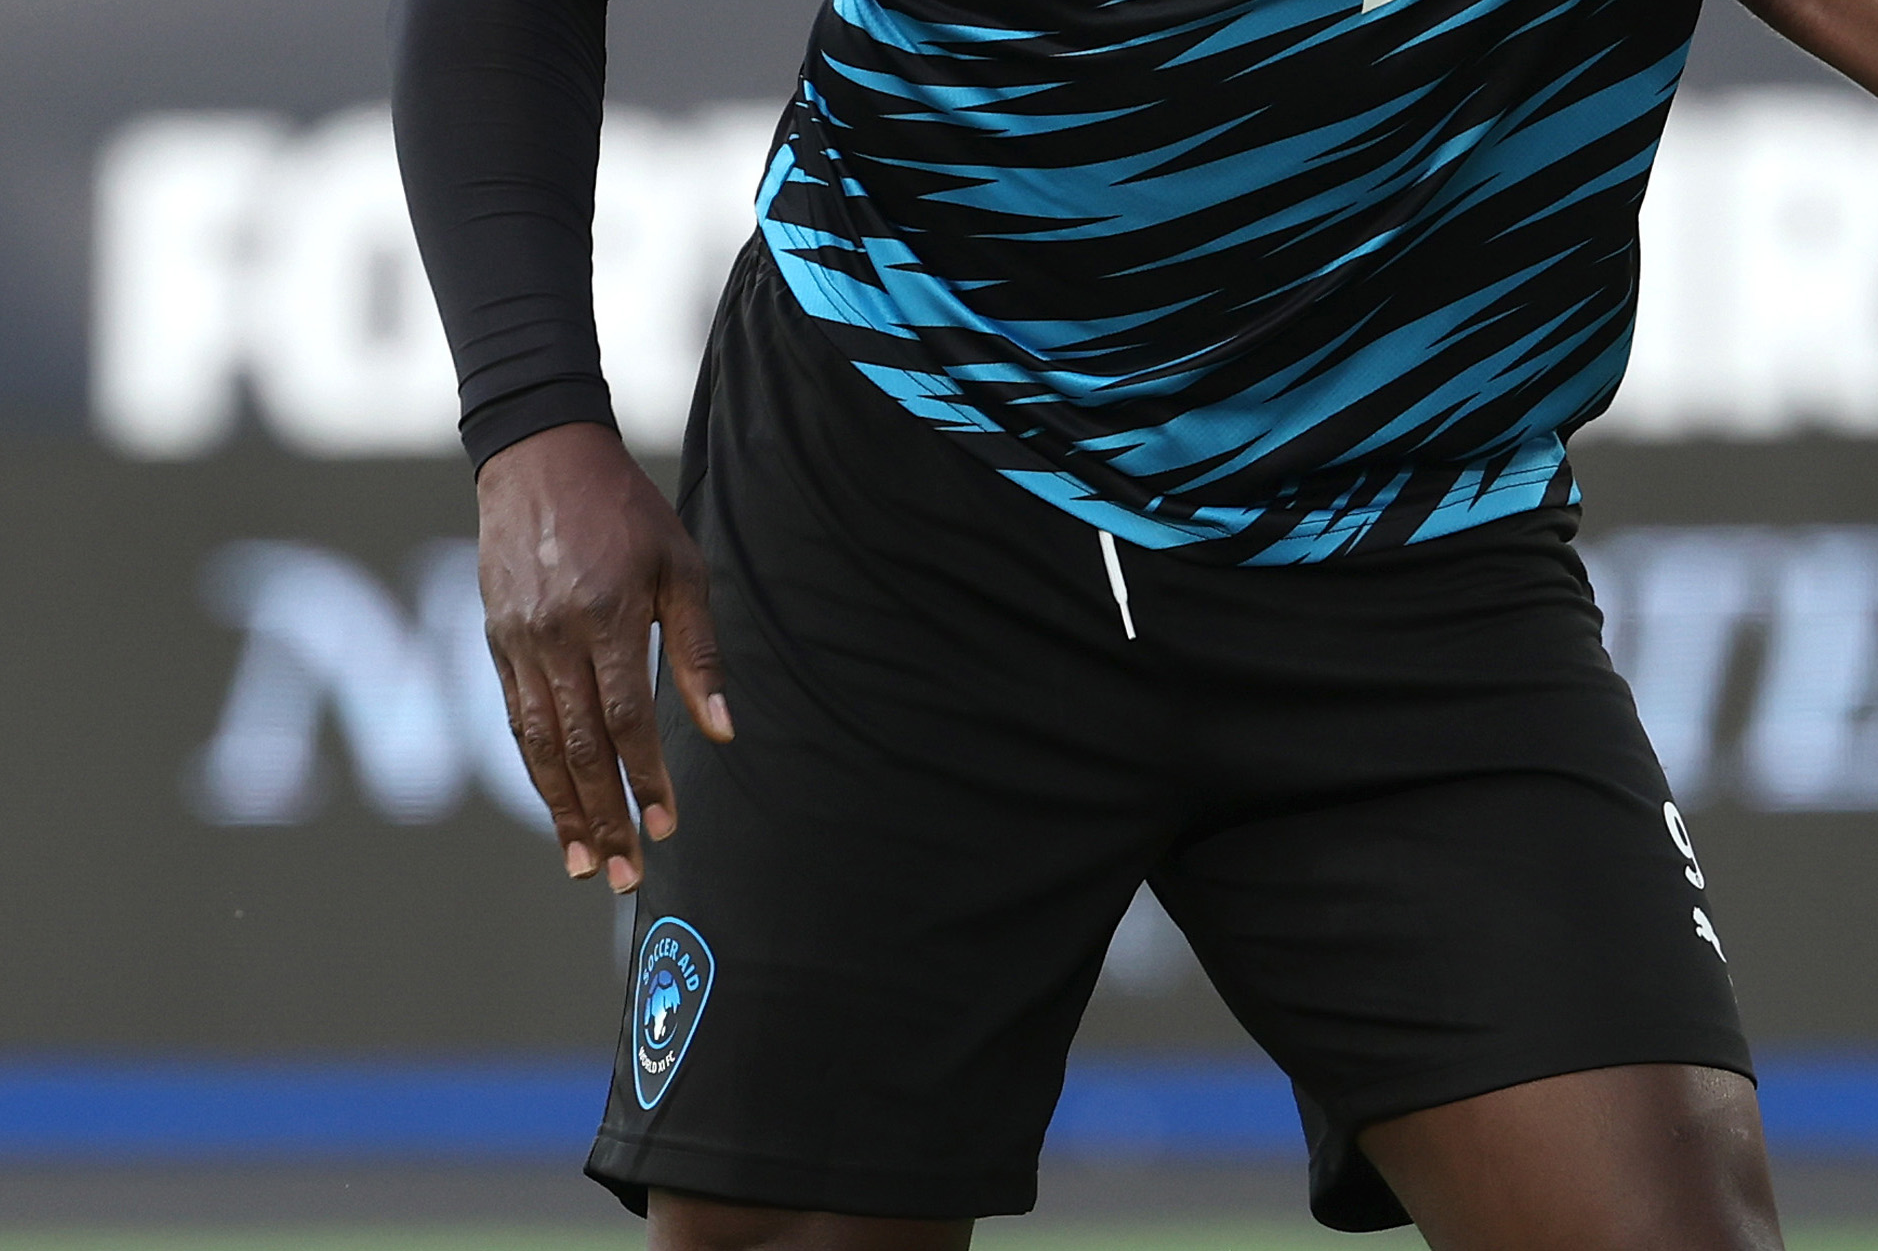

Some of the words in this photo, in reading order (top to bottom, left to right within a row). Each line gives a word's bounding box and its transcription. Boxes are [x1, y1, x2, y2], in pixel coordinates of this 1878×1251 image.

[1663, 801, 1705, 889] 9
[643, 938, 678, 985] SOCCER
[678, 953, 699, 991] AID
